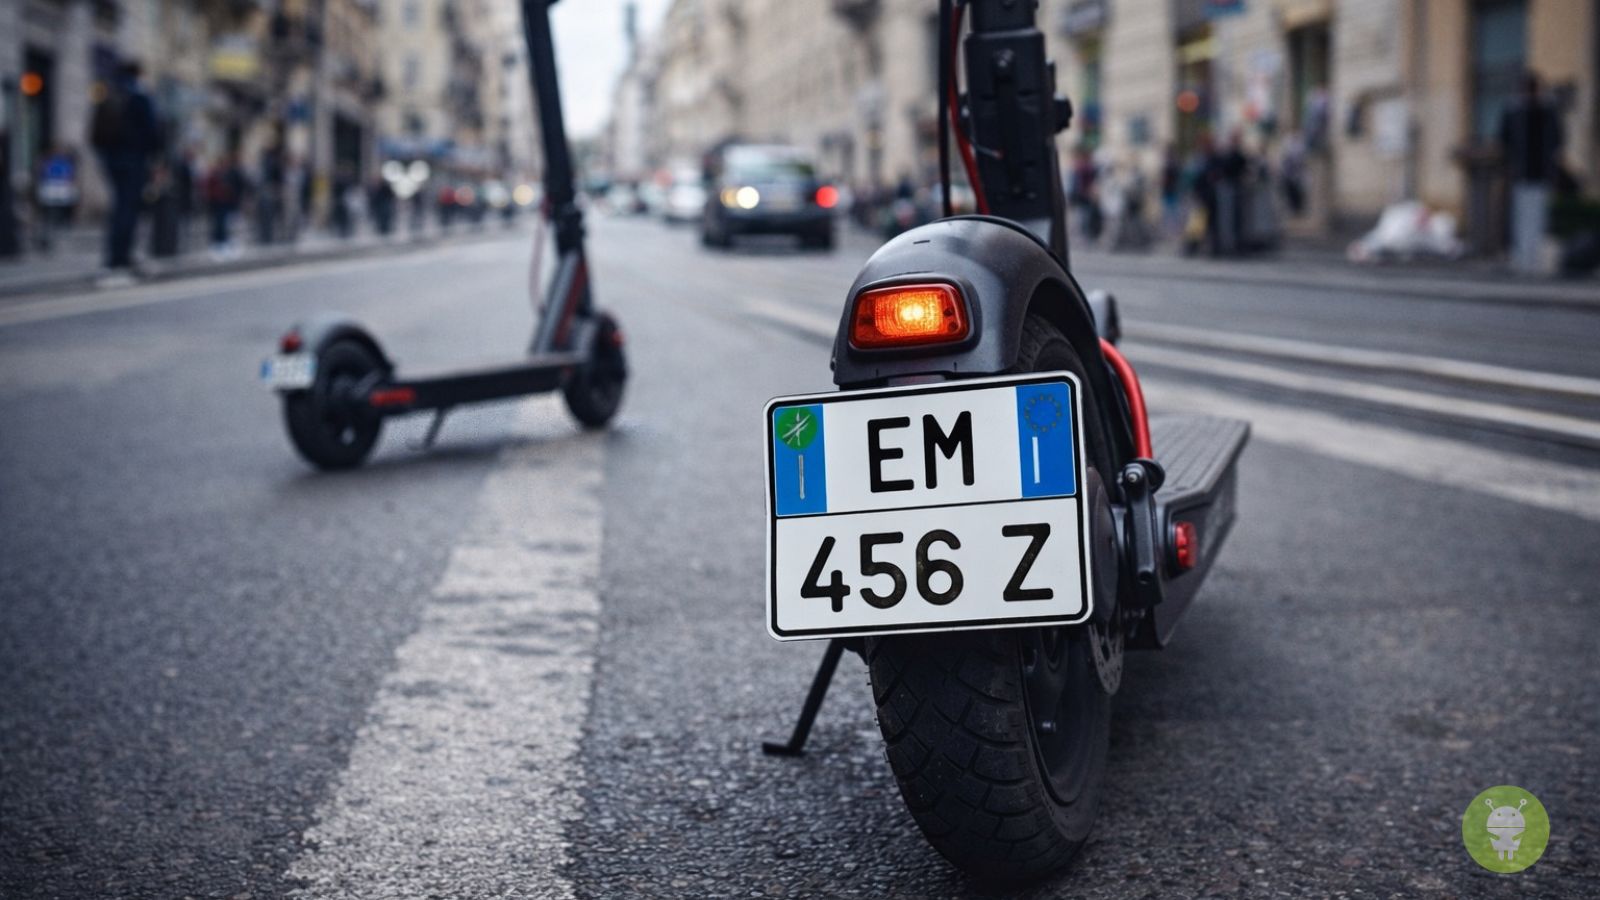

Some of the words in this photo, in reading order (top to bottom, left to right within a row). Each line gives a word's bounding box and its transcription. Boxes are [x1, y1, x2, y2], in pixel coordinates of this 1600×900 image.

[867, 411, 975, 493] EM
[800, 529, 964, 613] 456
[1002, 523, 1054, 602] Z
